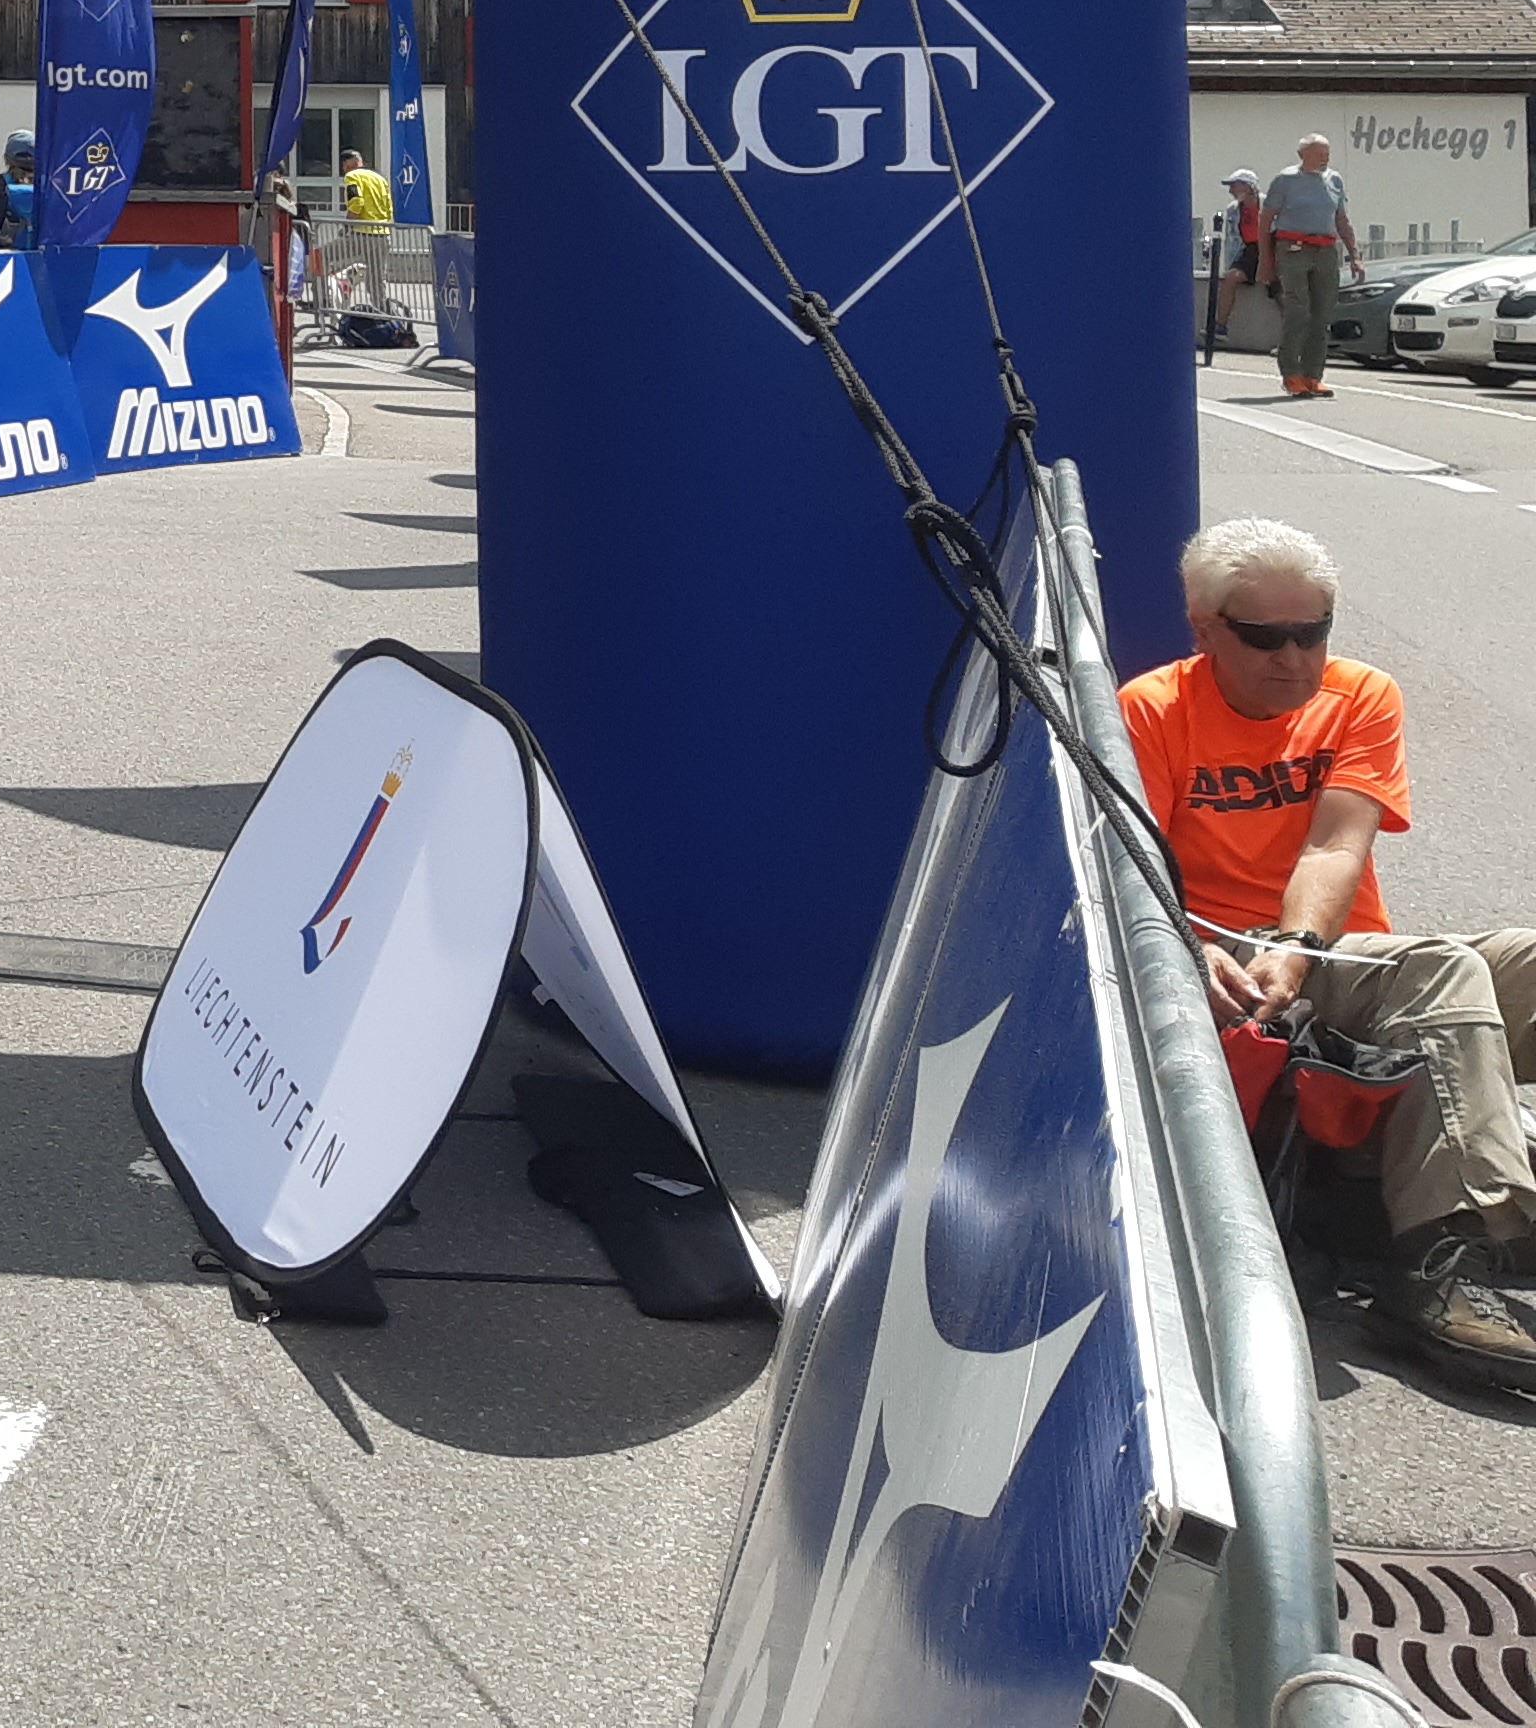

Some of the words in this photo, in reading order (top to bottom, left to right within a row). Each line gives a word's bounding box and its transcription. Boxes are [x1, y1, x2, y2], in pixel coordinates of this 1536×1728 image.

[46, 61, 149, 93] lgt.com
[645, 44, 979, 174] LGT
[1350, 115, 1489, 160] Hochegg
[1503, 119, 1516, 150] 1
[65, 165, 116, 196] LGT
[184, 957, 346, 1189] LIECHTENSTEIN
